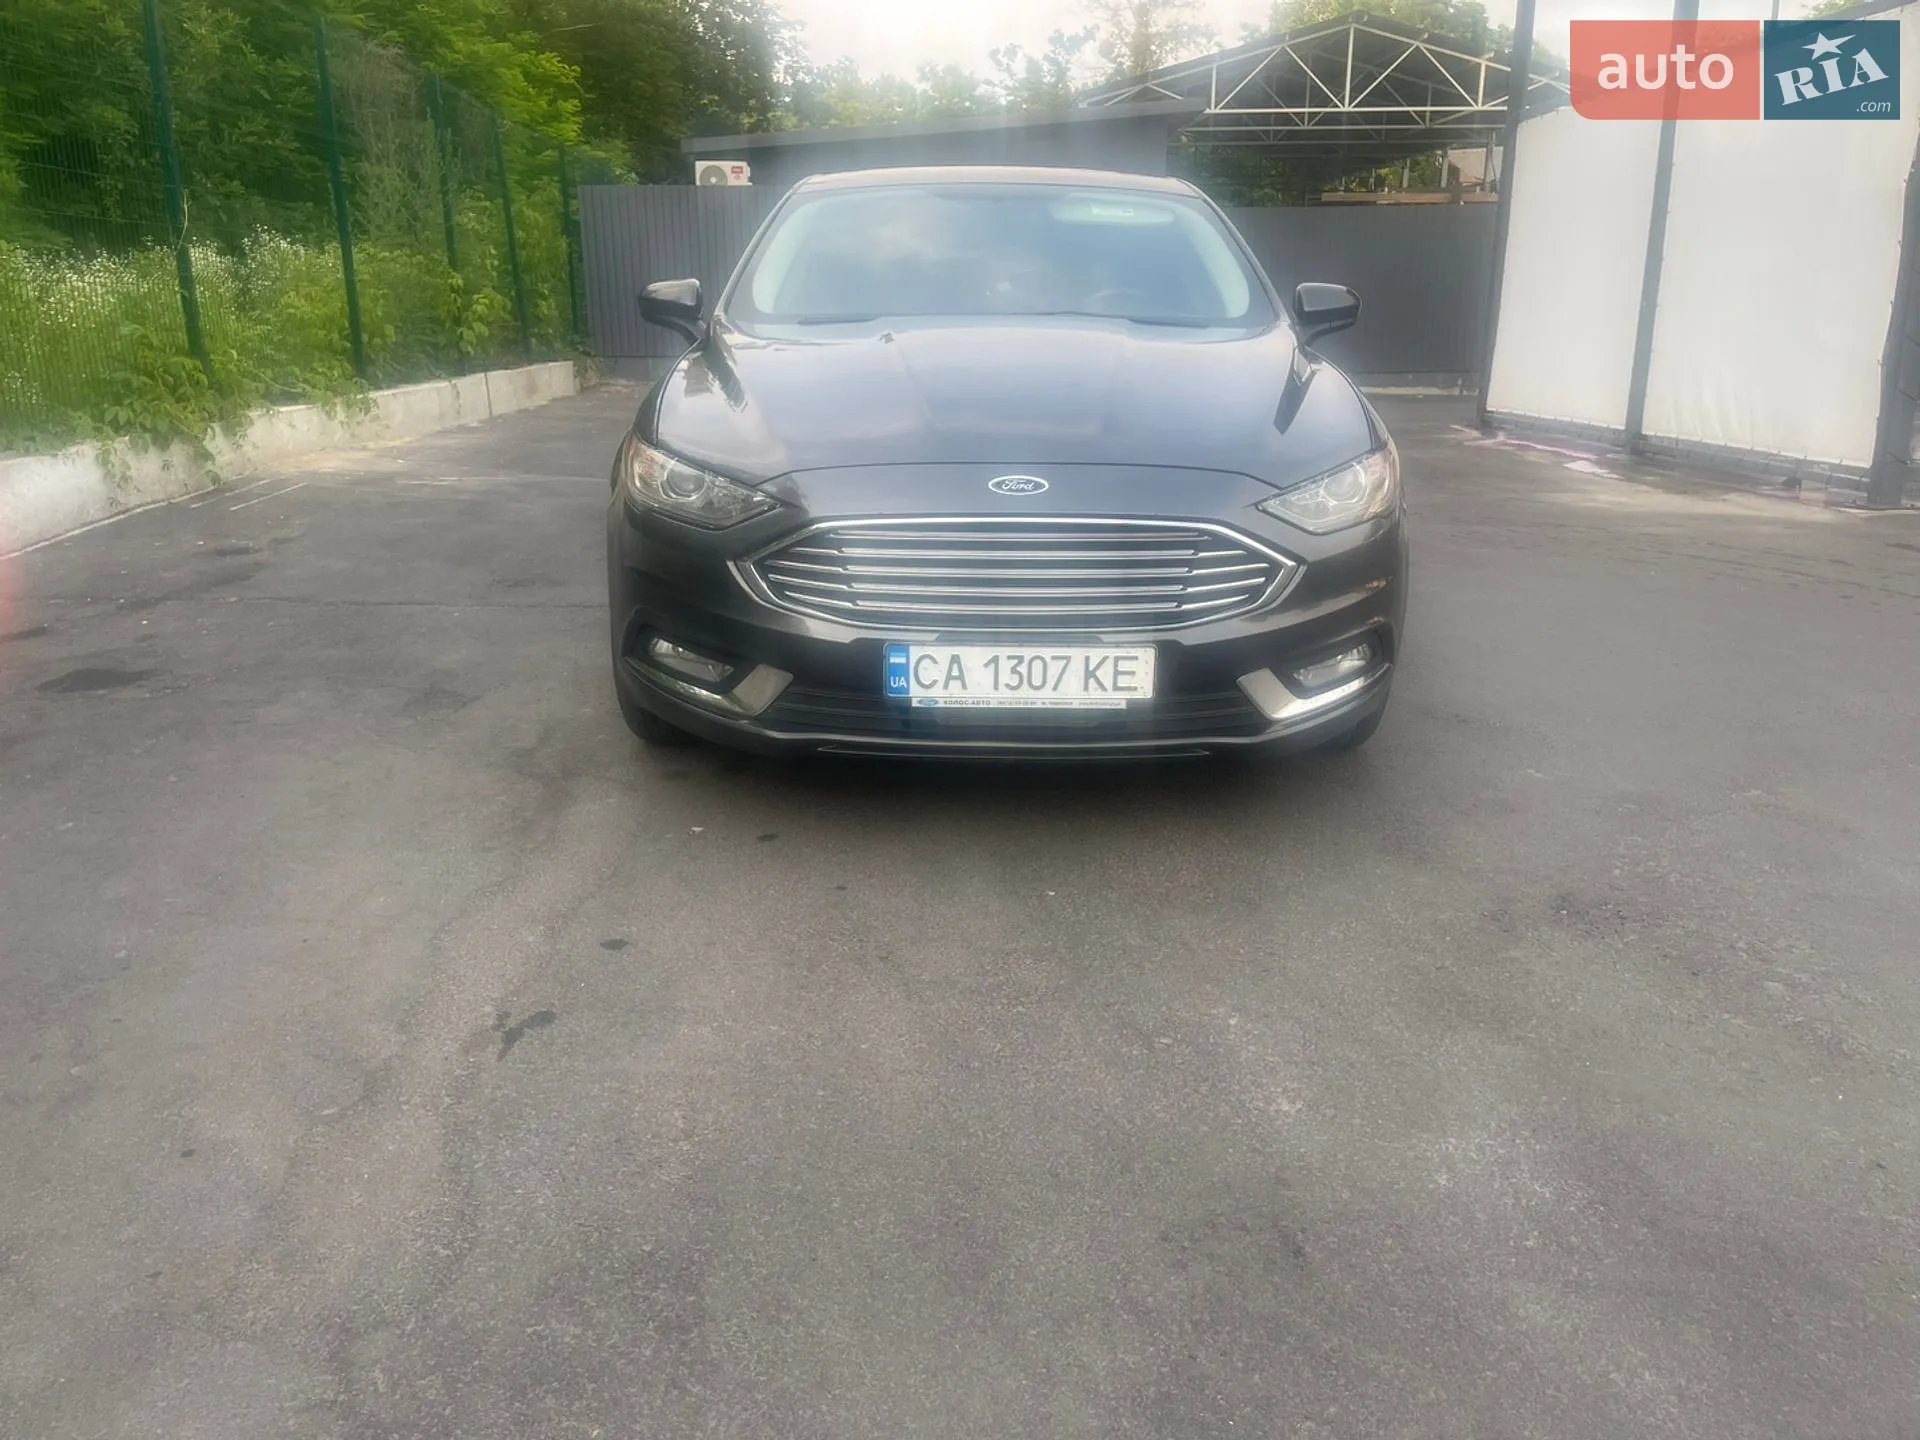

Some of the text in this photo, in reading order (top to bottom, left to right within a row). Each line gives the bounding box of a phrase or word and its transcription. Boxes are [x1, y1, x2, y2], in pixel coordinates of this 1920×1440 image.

[1002, 480, 1034, 491] Ford
[913, 653, 1139, 693] CA 1307 KE
[890, 676, 908, 689] UA
